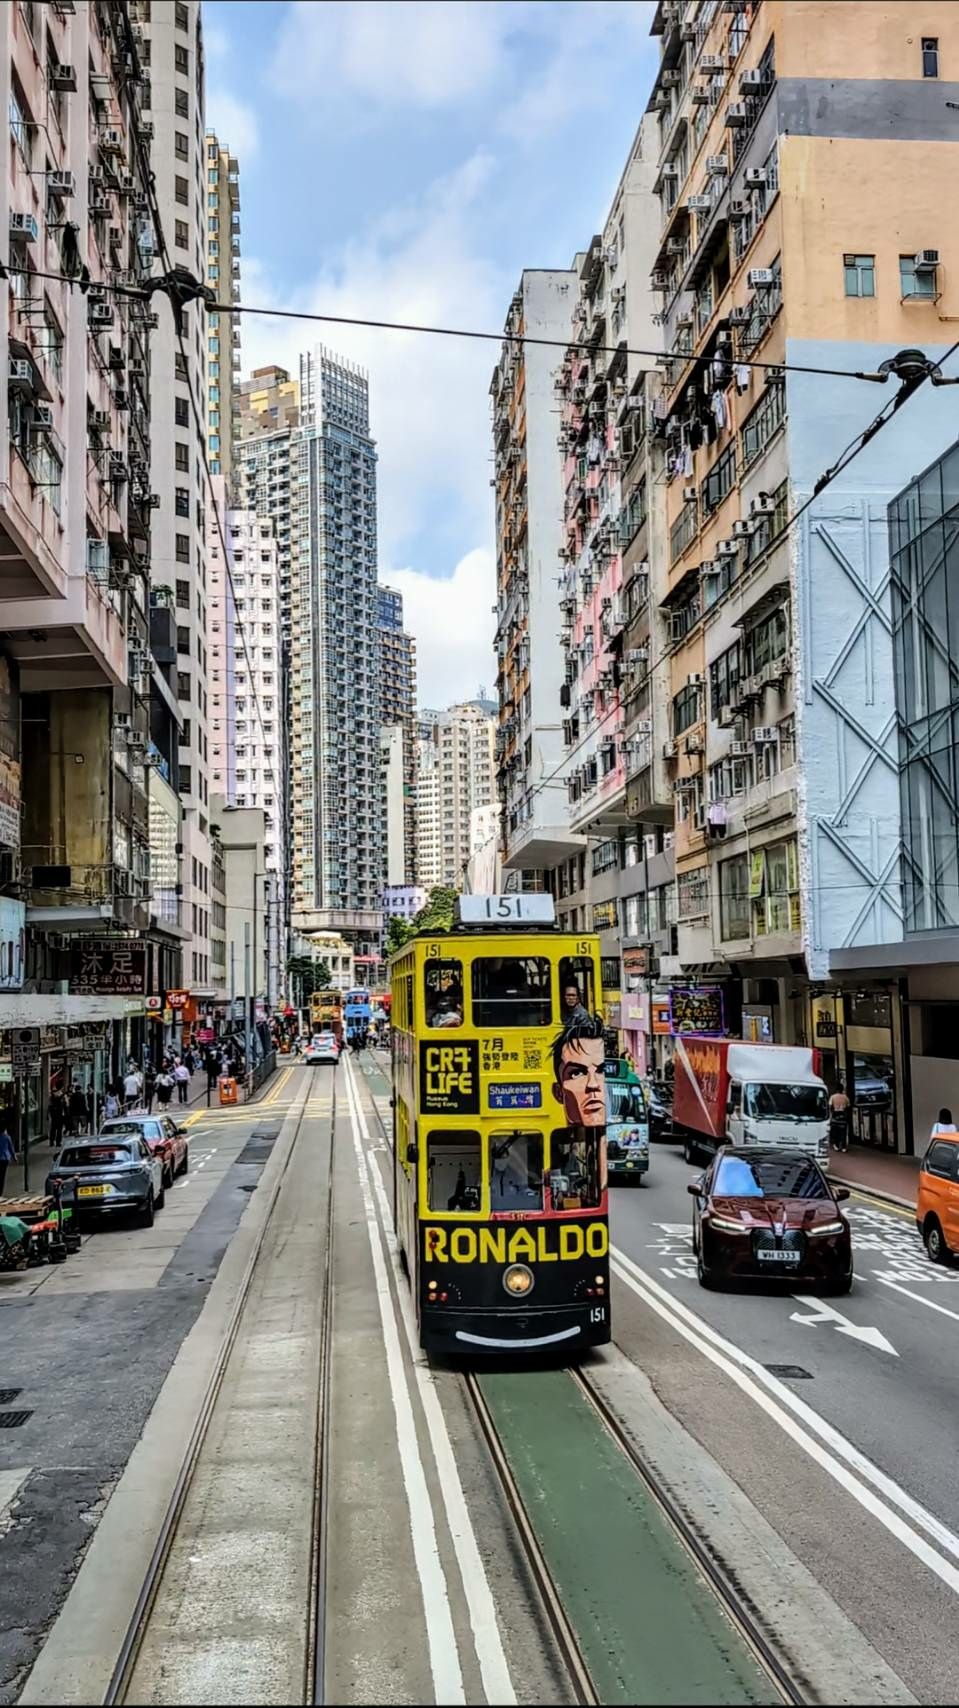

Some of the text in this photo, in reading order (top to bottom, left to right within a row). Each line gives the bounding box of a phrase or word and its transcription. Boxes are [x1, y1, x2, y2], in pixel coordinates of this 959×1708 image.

[485, 897, 522, 918] 151
[425, 944, 441, 957] 151
[576, 942, 592, 955] 151
[81, 952, 133, 974] 沐足
[482, 1038, 503, 1051] 7月
[483, 1062, 500, 1071] 香港
[426, 1072, 472, 1094] LIFE
[489, 1084, 540, 1095] Shaukeiwan
[442, 1101, 458, 1109] Kong
[425, 1222, 609, 1263] RONALDO
[590, 1307, 605, 1322] 151
